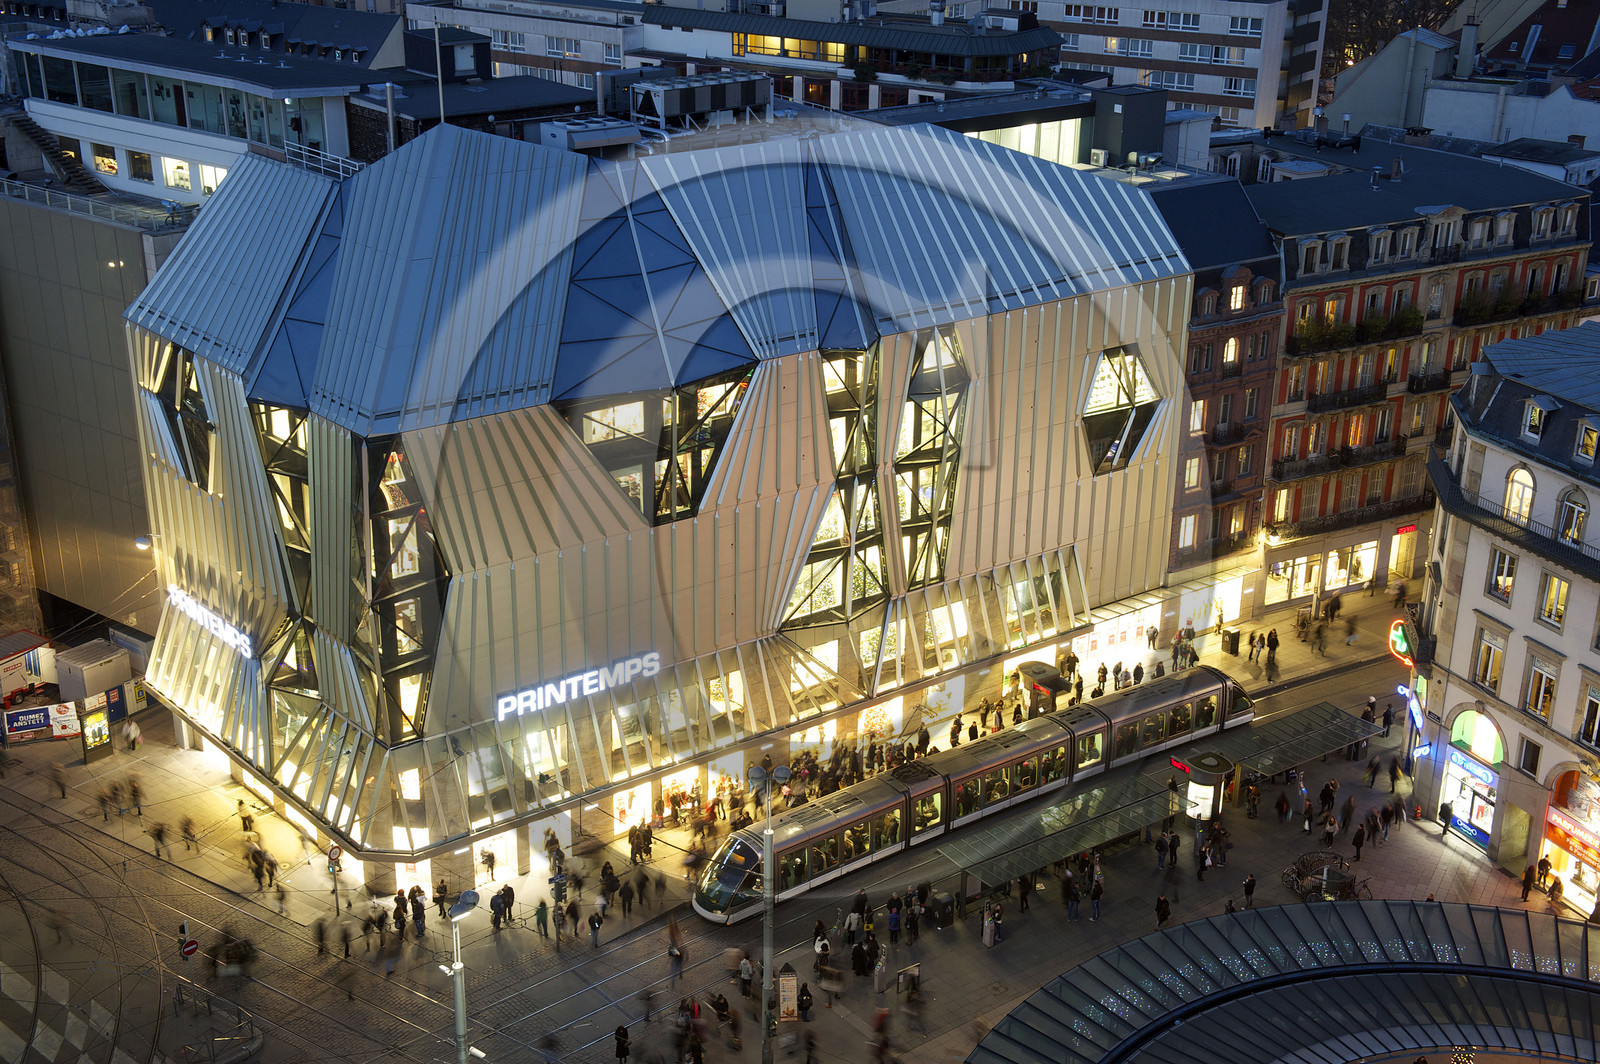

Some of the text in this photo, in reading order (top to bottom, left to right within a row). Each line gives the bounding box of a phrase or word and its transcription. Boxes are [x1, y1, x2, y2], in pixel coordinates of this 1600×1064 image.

[168, 584, 252, 659] PRINTEMPS
[497, 652, 660, 722] PRINTEMPS
[13, 717, 45, 728] ANSTETT
[19, 713, 44, 721] DUMEZ
[1552, 813, 1600, 849] PARFUMERIE
